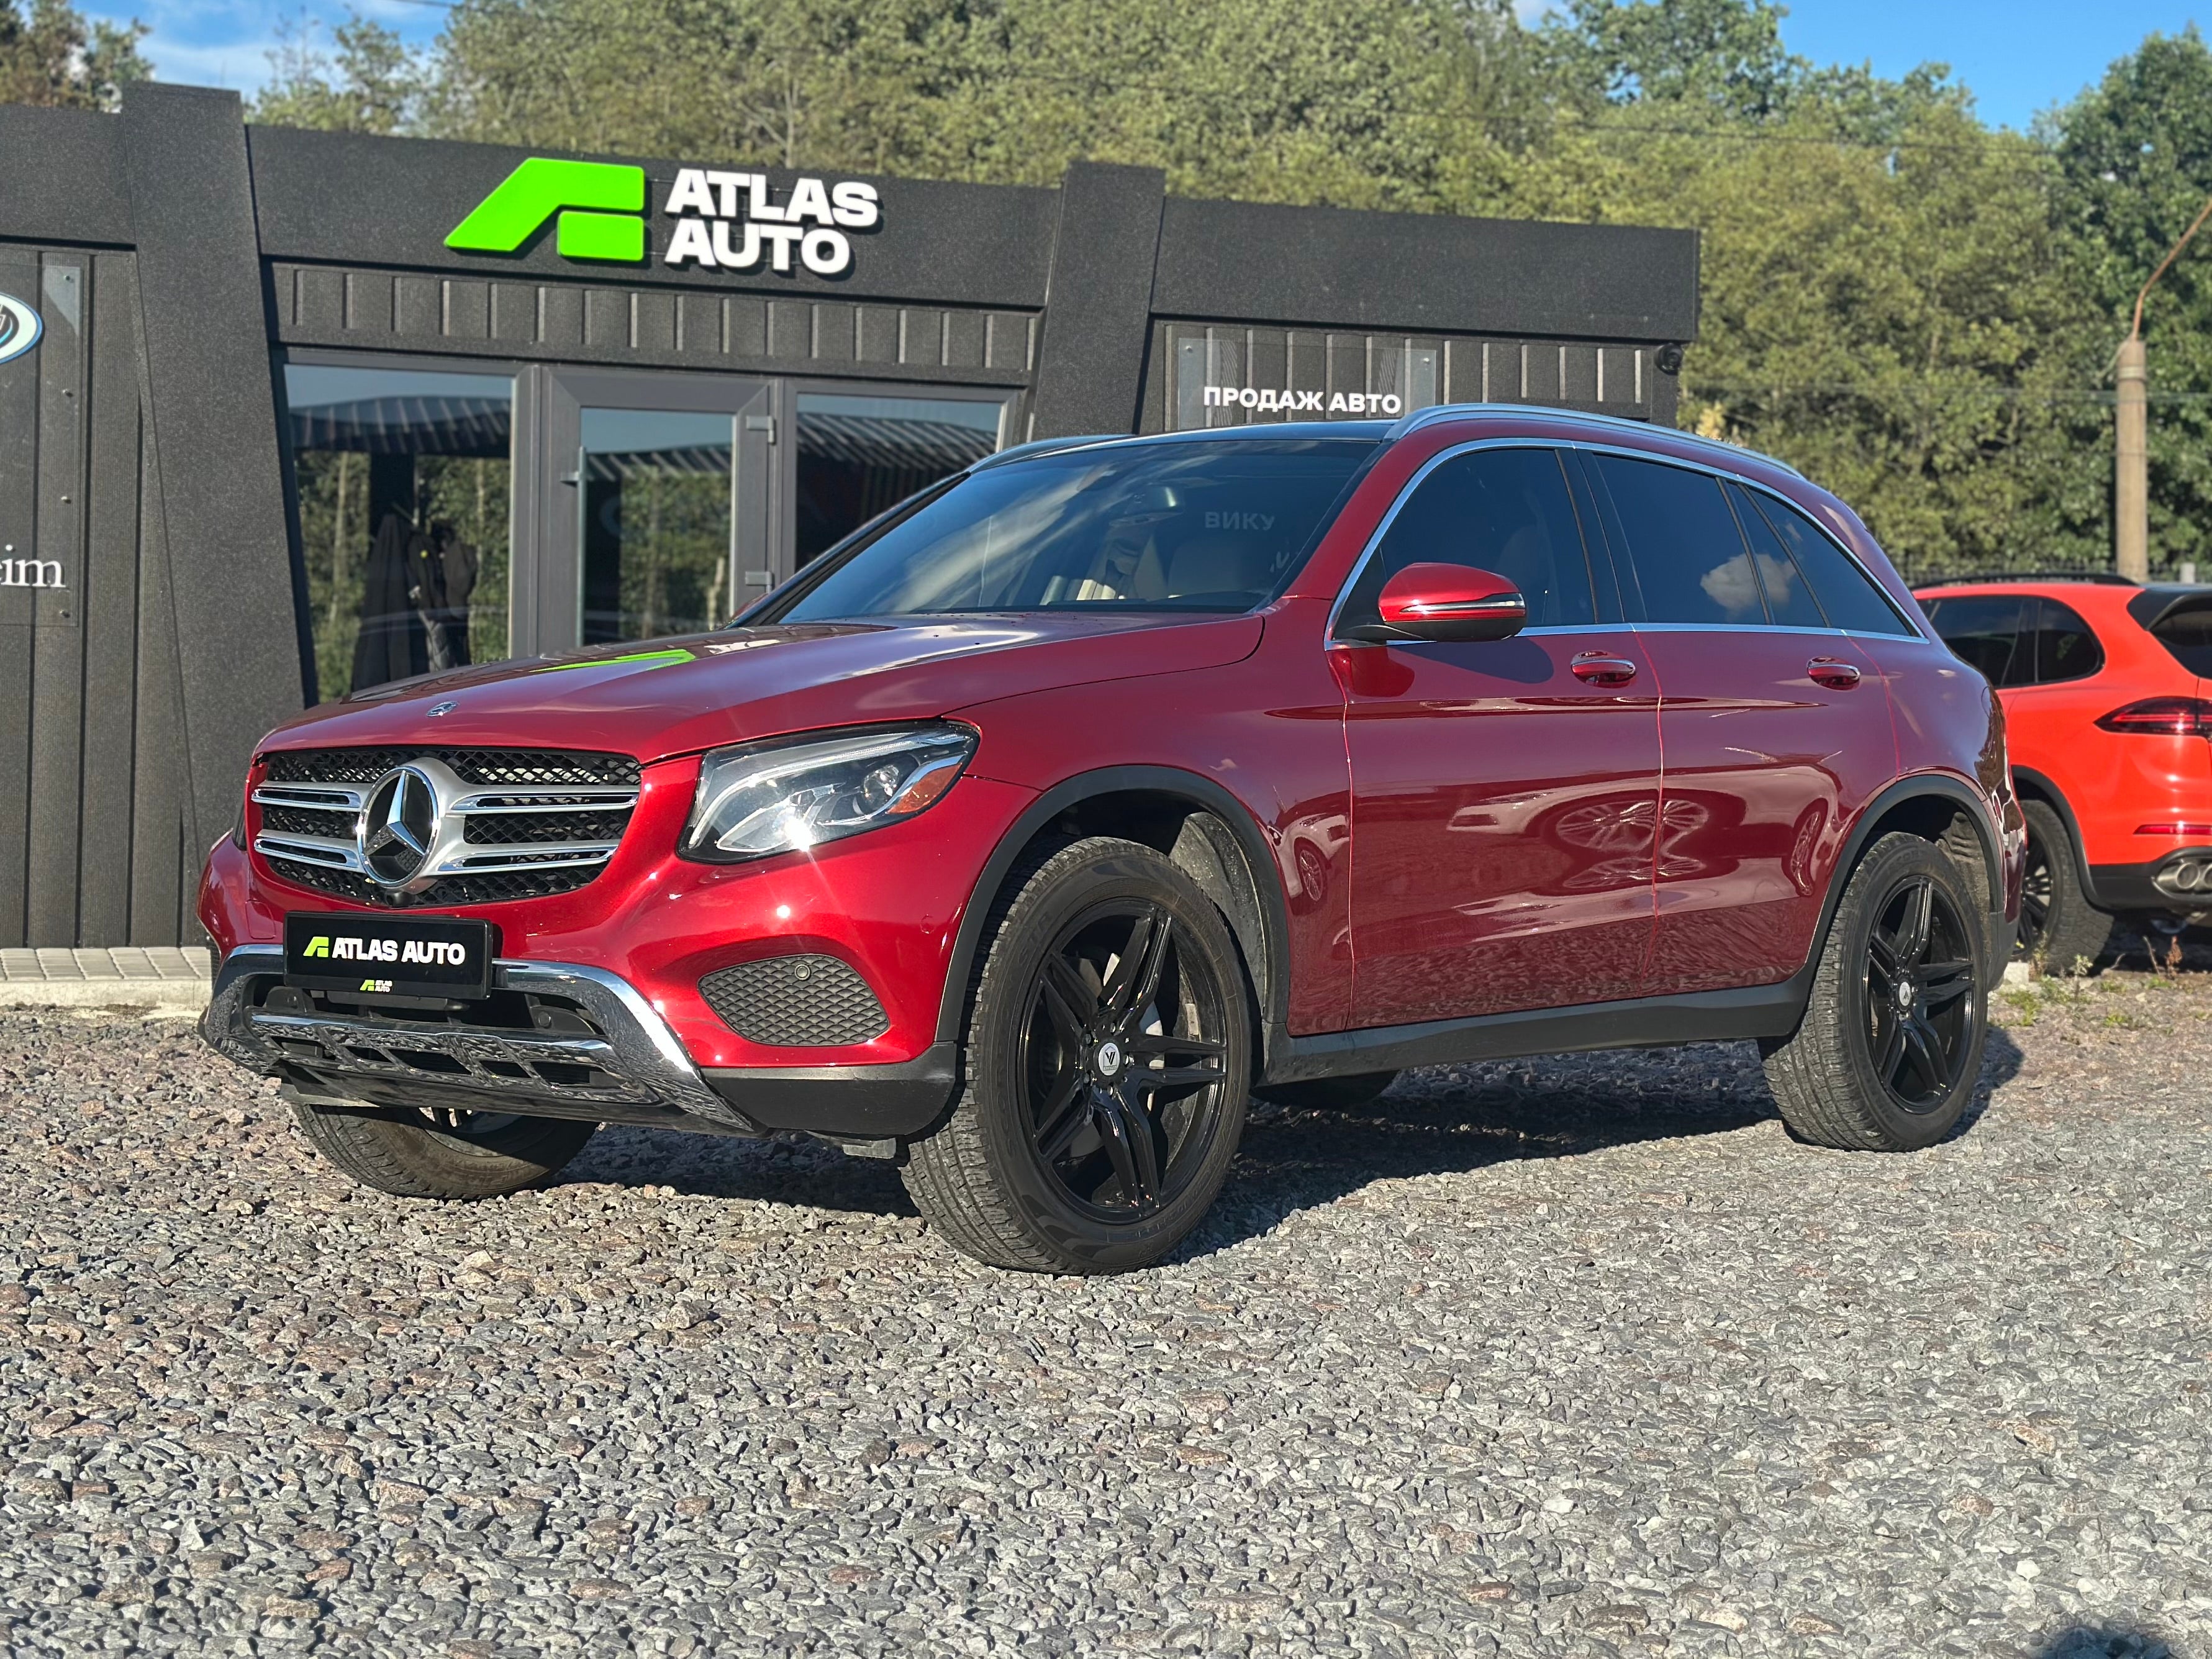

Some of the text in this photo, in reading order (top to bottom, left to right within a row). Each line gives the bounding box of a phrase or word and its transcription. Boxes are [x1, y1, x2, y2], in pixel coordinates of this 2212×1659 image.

[664, 168, 878, 227] ATLAS
[664, 218, 850, 275] AUTO
[1203, 386, 1402, 415] ПРОДАЖ АВТО
[0, 544, 66, 588] im
[332, 937, 466, 965] ATLAS AUTO
